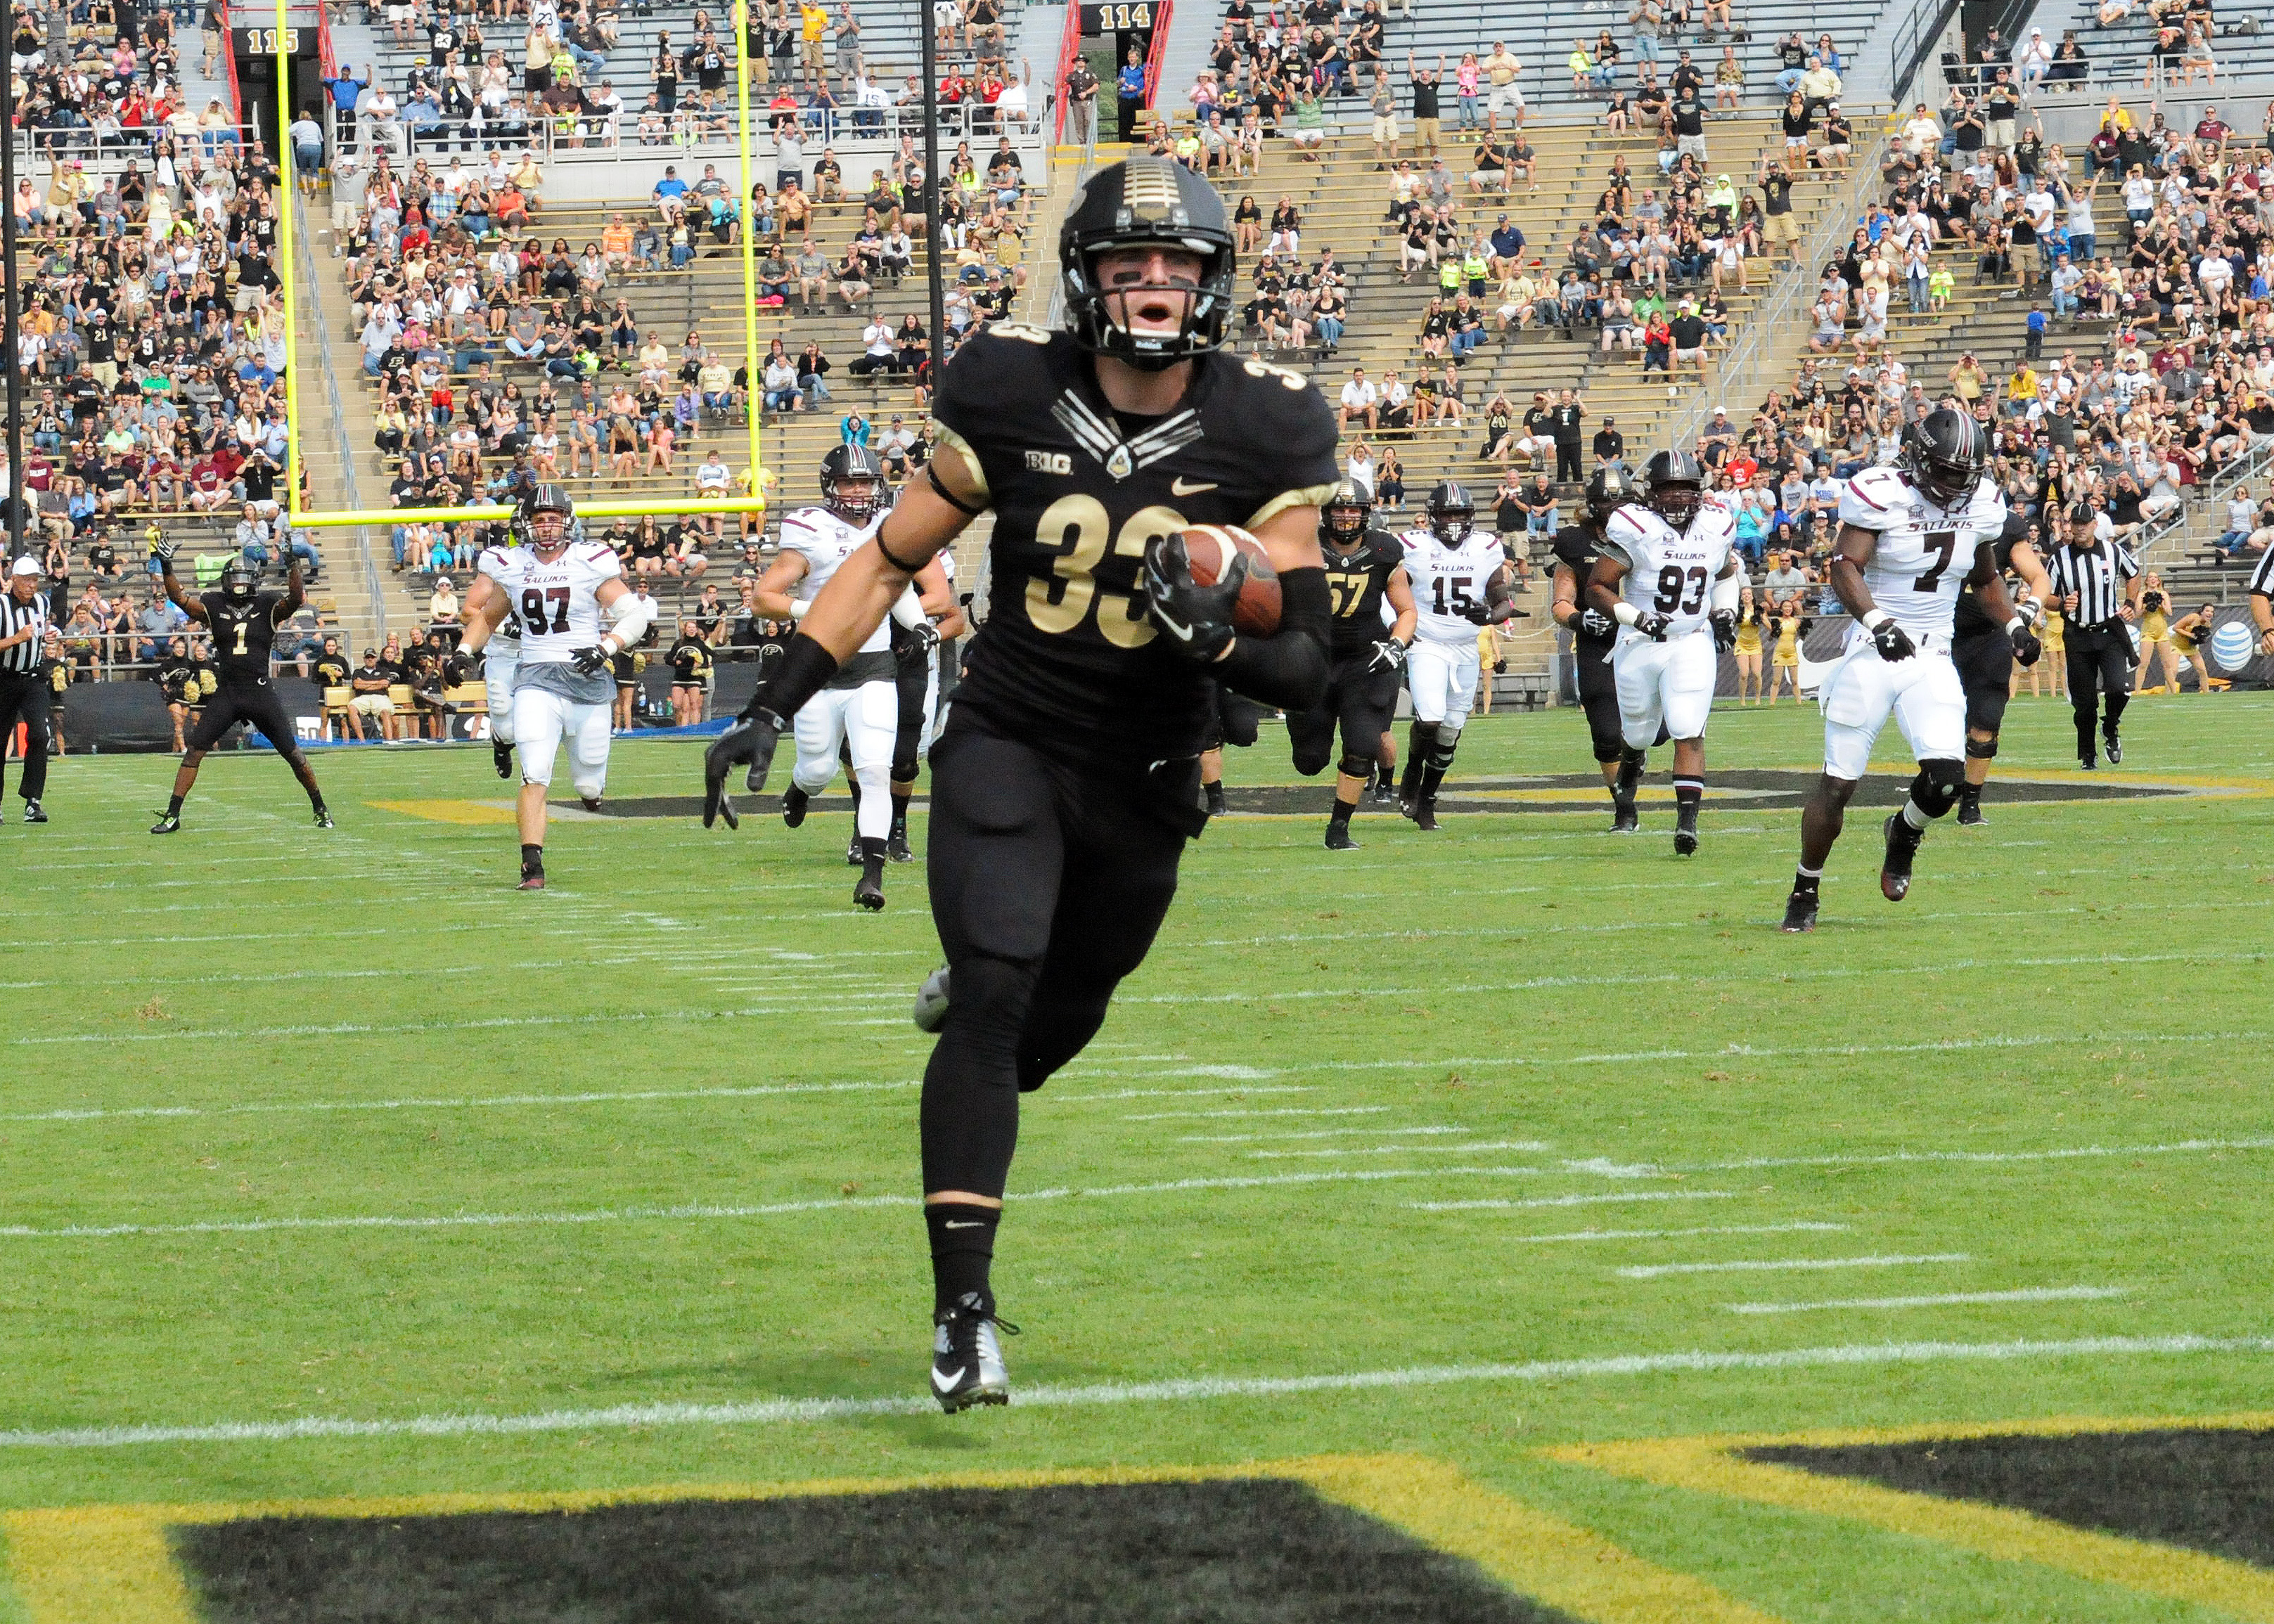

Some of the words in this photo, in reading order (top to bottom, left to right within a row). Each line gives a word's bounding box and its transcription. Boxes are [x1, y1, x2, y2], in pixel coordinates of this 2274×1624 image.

[1099, 4, 1150, 30] 114
[248, 29, 300, 53] 115
[433, 32, 453, 49] 23
[257, 221, 271, 235] 12
[142, 338, 154, 356] 9
[40, 415, 58, 433] 12
[1906, 520, 1974, 533] SALUKIS
[1662, 550, 1707, 560] SALUKIS
[1913, 530, 1955, 593] 7
[522, 574, 570, 586] SALUKIS
[1025, 494, 1190, 648] 33
[1330, 573, 1370, 618] 57
[1432, 576, 1472, 617] 15
[1653, 565, 1707, 615] 93
[522, 586, 572, 636] 97
[232, 622, 248, 655] 1
